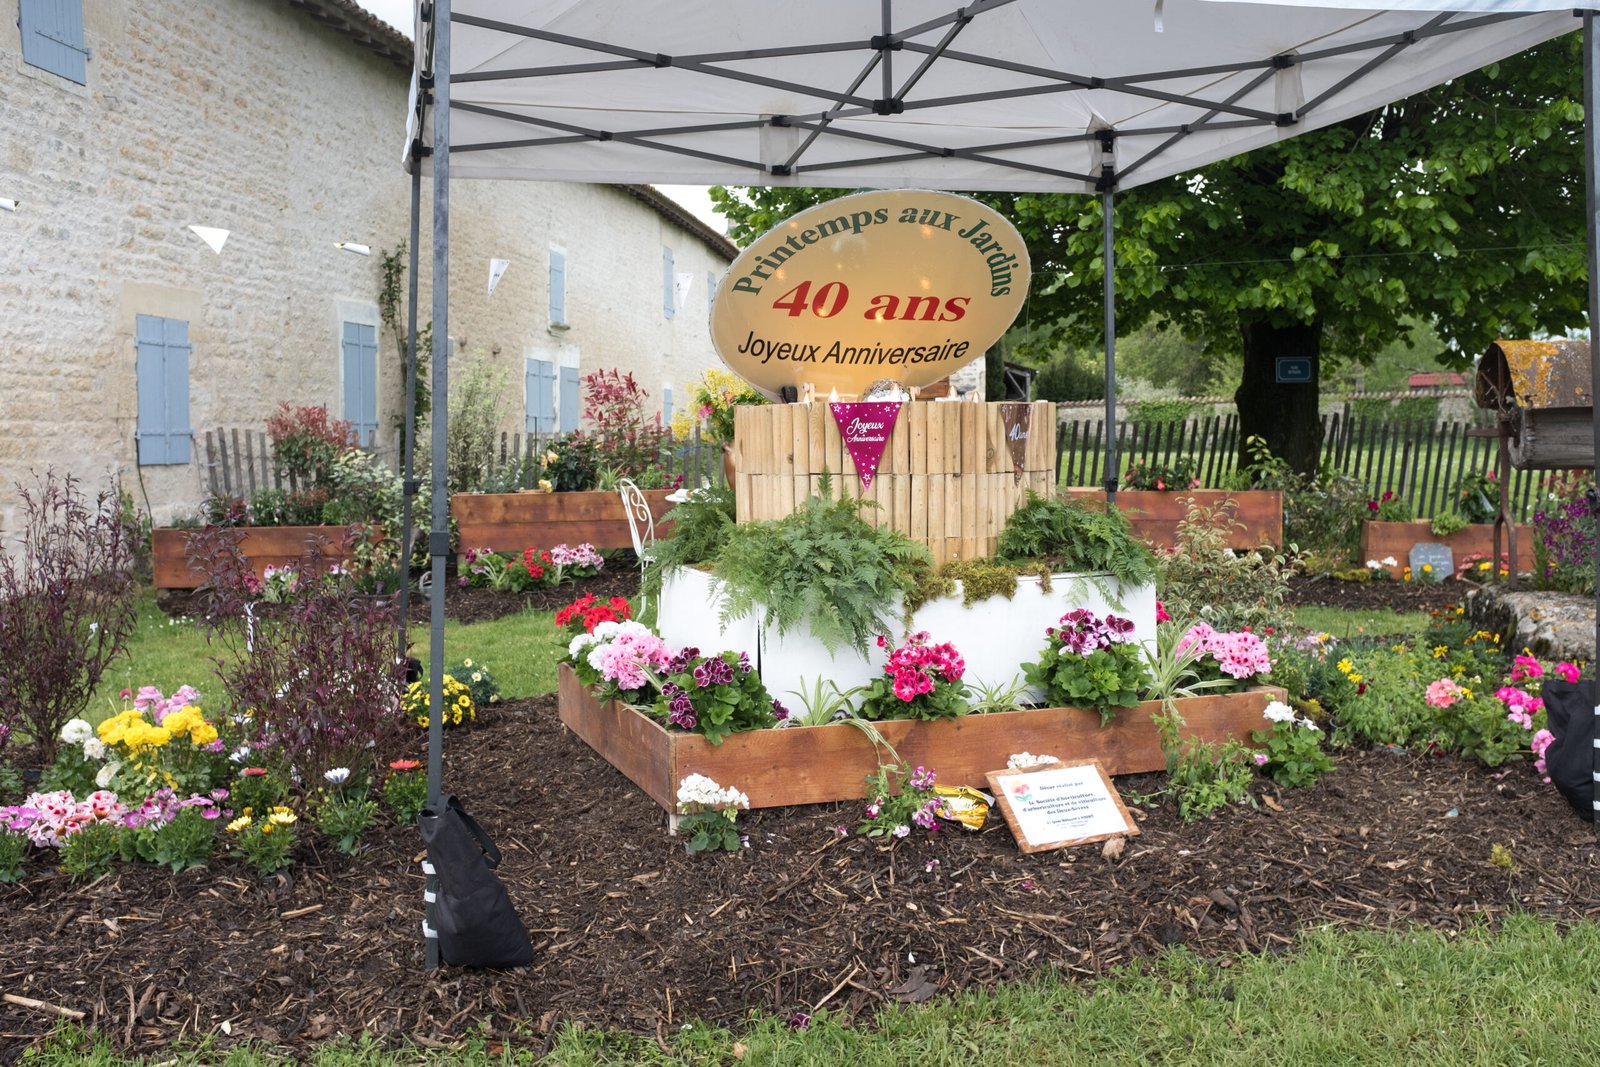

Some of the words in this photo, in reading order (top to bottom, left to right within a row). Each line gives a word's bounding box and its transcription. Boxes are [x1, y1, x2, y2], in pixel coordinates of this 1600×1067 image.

[731, 207, 889, 297] Printemps
[897, 206, 961, 232] aux
[958, 218, 1019, 298] Jardins
[772, 280, 849, 318] 40
[863, 294, 971, 322] ans
[738, 331, 821, 365] Joyeux
[821, 339, 970, 366] Anniversaire
[846, 417, 884, 434] Joyeux
[846, 434, 885, 443] Anniversaire
